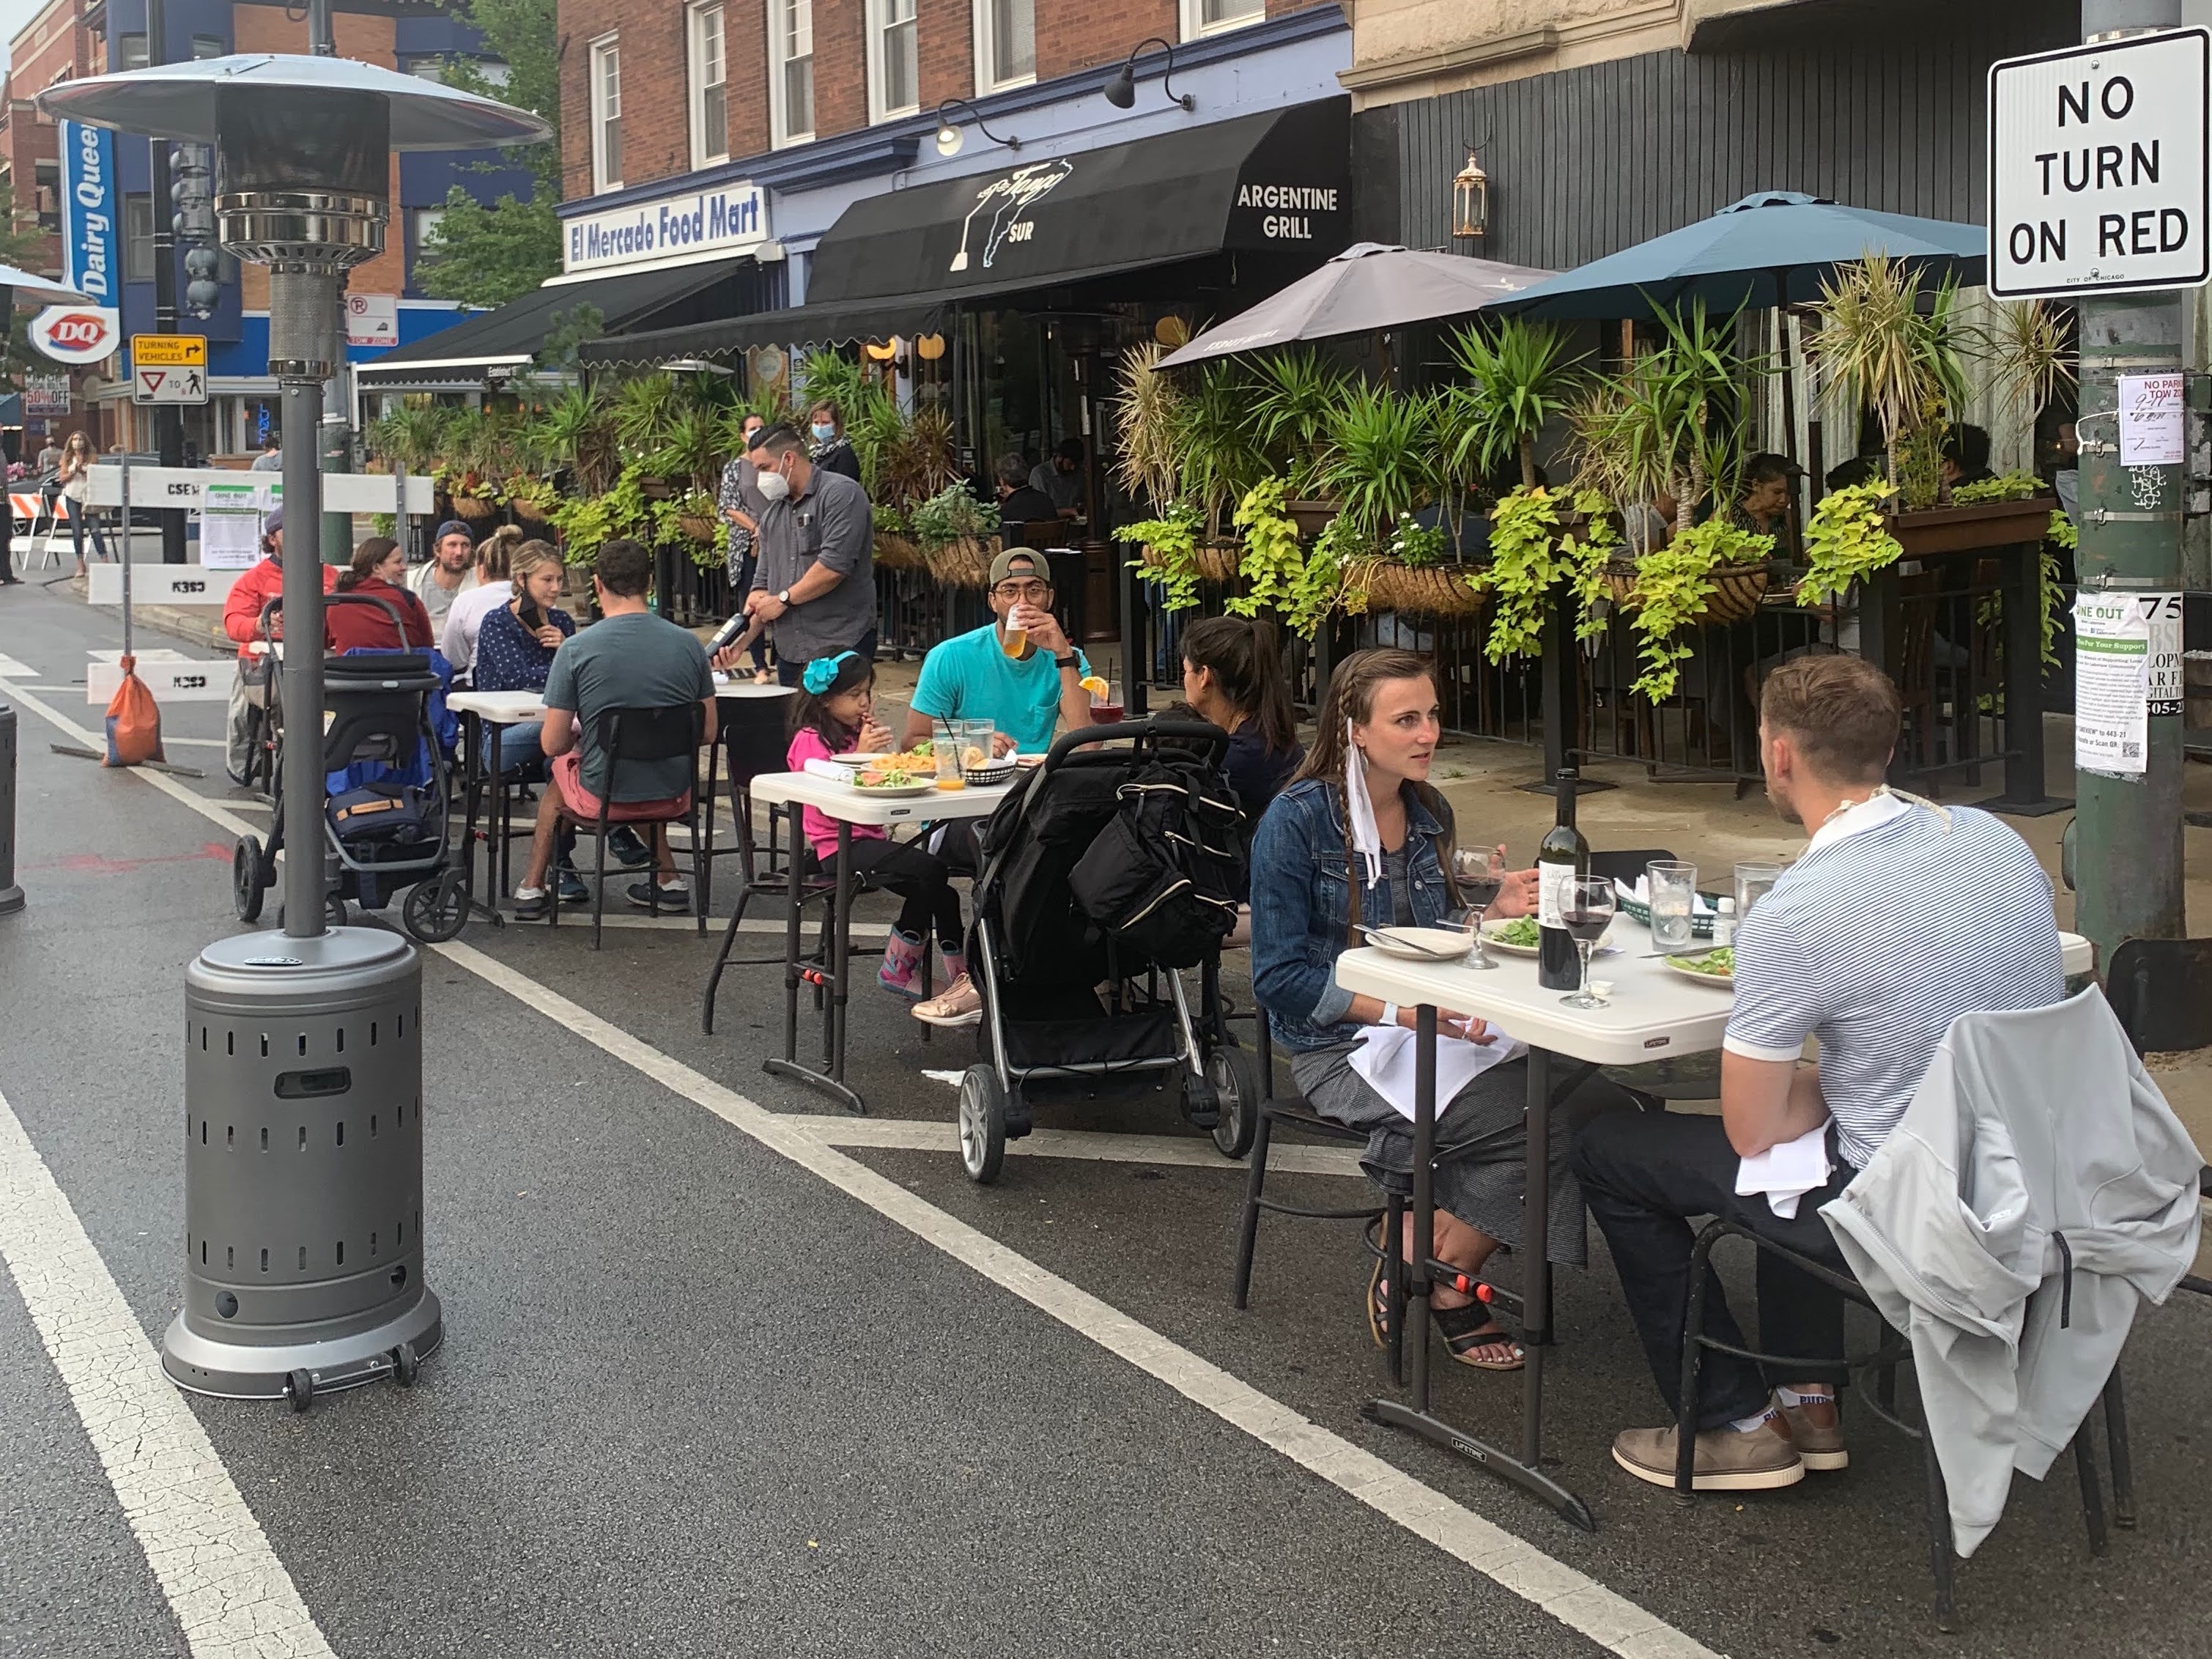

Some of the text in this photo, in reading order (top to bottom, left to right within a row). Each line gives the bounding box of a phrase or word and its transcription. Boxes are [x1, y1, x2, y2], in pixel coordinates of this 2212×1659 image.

[2058, 76, 2134, 128] NO
[2035, 139, 2159, 196] TURN
[1238, 184, 1337, 211] ARGENTINE
[572, 191, 758, 262] El Mercado Food Mart
[1008, 221, 1035, 243] SUR
[1263, 215, 1312, 239] GRILL
[2009, 208, 2189, 265] ON RED
[80, 213, 110, 296] Dairy
[57, 322, 98, 344] DQ
[138, 341, 180, 350] TURNING
[138, 352, 182, 361] VEHICLES
[169, 380, 180, 388] TO
[2145, 381, 2159, 389] NO
[2150, 390, 2171, 398] TOW
[52, 391, 69, 403] OFF
[2096, 607, 2124, 620] OUT
[2114, 642, 2145, 651] Support
